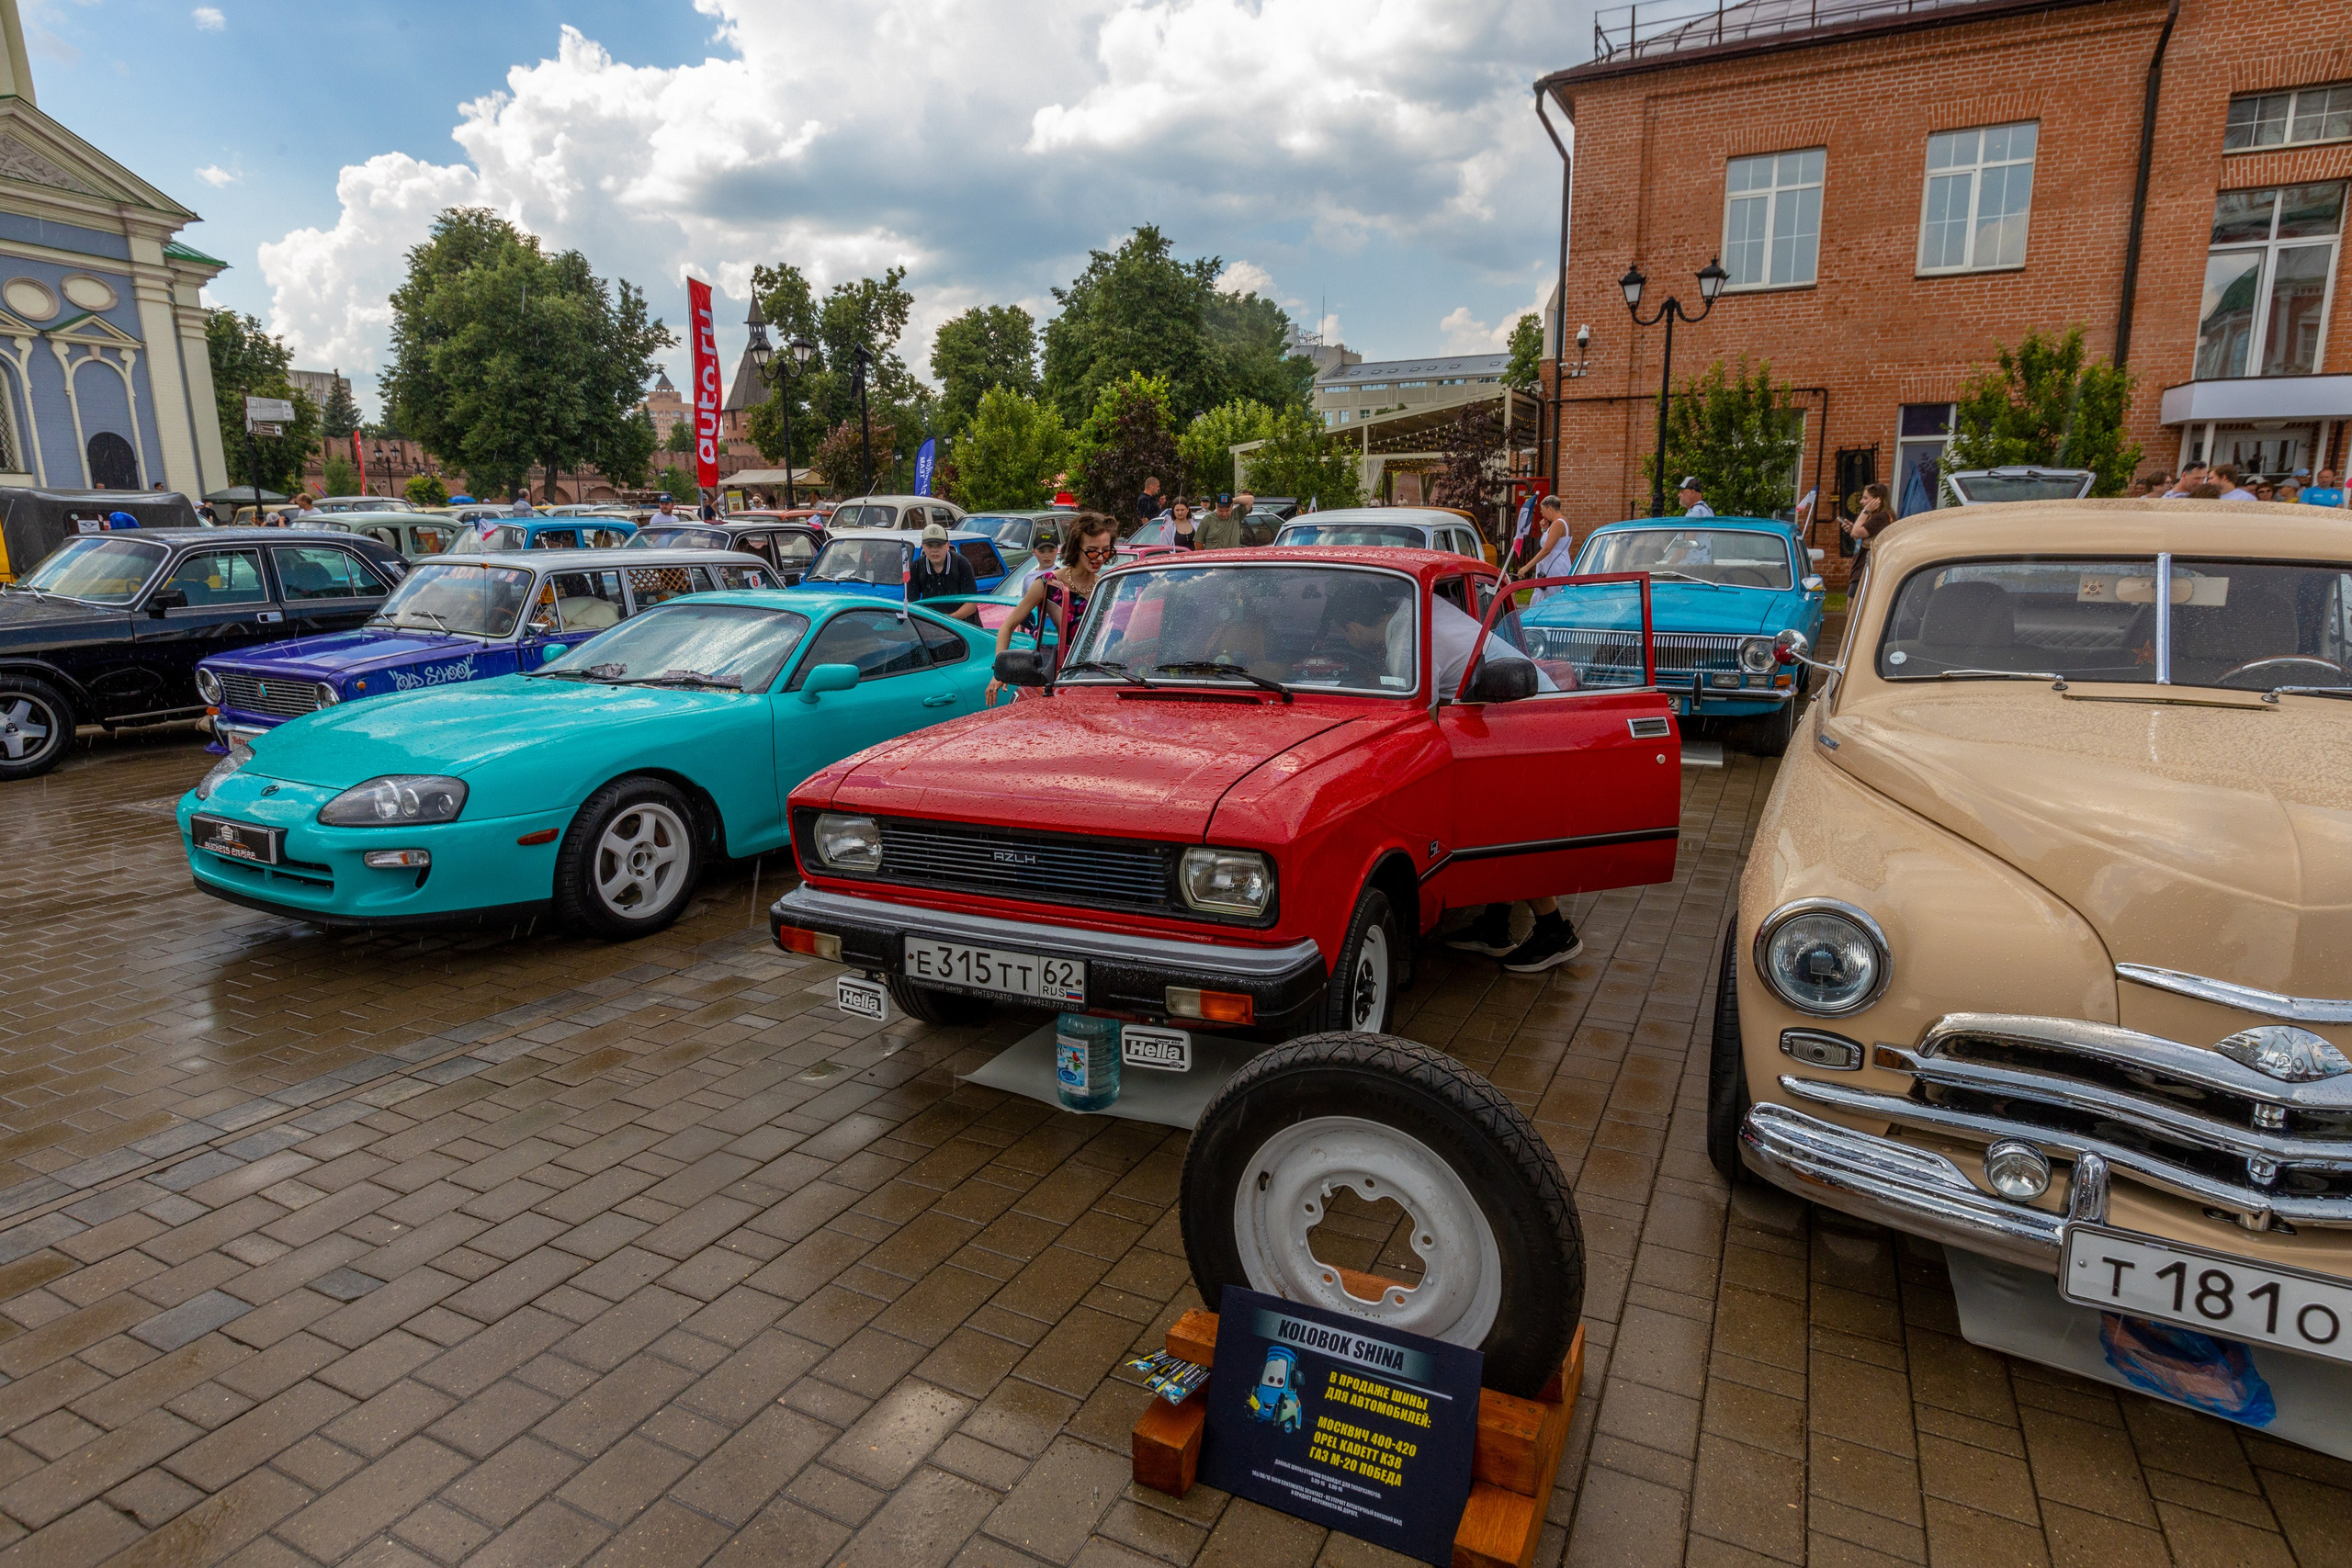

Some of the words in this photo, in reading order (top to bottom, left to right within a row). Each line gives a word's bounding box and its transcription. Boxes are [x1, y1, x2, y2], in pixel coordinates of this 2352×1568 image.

[698, 309, 718, 465] auto.ru
[441, 566, 477, 580] LADA
[752, 575, 758, 587] 6
[1043, 960, 1074, 988] 62
[842, 990, 878, 1010] Hella
[972, 988, 1013, 1001] ИНТЕРАВТО
[1042, 986, 1066, 997] RUS
[1129, 1040, 1181, 1060] Hella
[1278, 1319, 1353, 1356] KOLOBOK
[1353, 1340, 1405, 1371] SHINA
[1329, 1371, 1338, 1383] В
[1339, 1373, 1390, 1400] ПРОДАЖЕ
[1391, 1387, 1429, 1411] ШИНЫ
[1324, 1386, 1349, 1402] ДЛЯ
[1349, 1393, 1432, 1428] АВТОМОБИЛЕЙ:
[1313, 1431, 1338, 1450] OPEL
[1339, 1438, 1380, 1461] KADETT
[1317, 1416, 1370, 1442] МОСКВИЧ
[1370, 1433, 1418, 1458] 400-420
[1308, 1446, 1329, 1463] ГАЗ
[1358, 1463, 1402, 1487] ПОБЕДА
